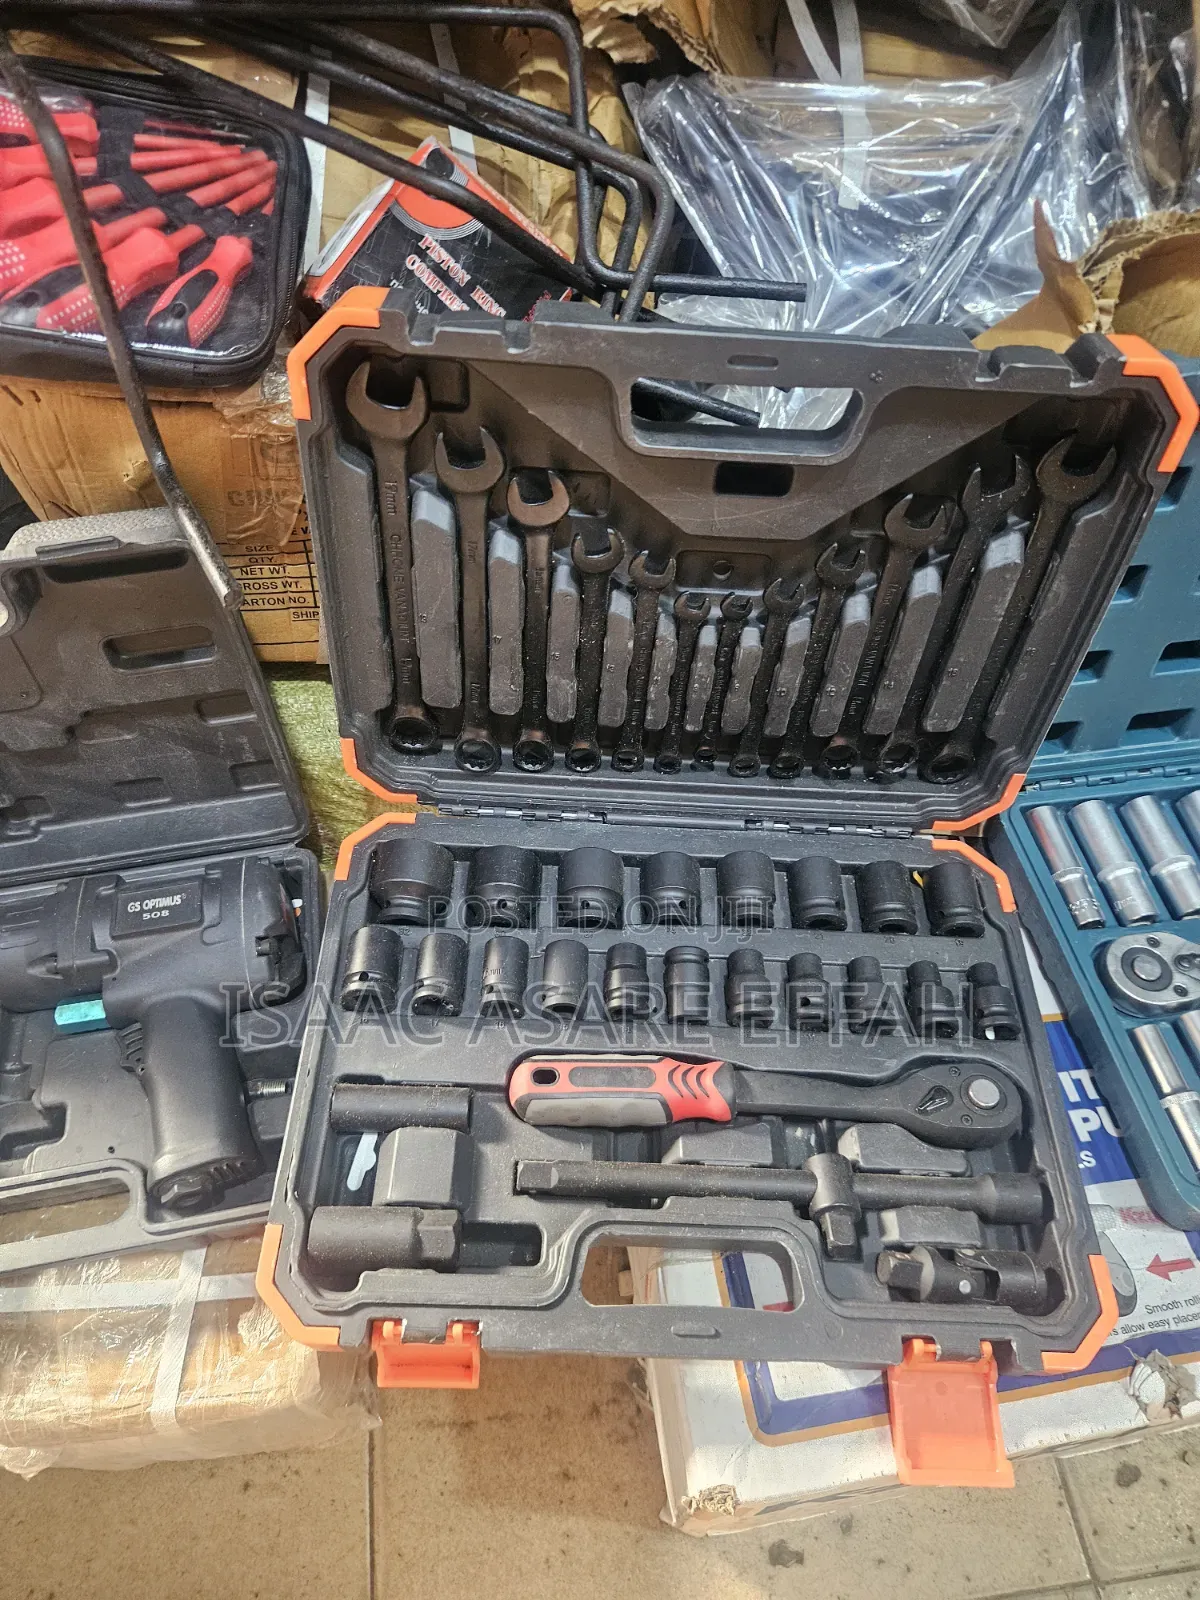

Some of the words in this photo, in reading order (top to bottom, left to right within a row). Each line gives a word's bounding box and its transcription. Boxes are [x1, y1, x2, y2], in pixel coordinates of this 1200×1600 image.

[418, 233, 472, 287] PISTON
[240, 567, 265, 576] NET
[269, 566, 290, 575] WT.
[240, 582, 278, 591] ROSS
[281, 581, 302, 589] WT.
[242, 598, 285, 607] ARTON
[127, 901, 141, 913] GS
[142, 910, 169, 920] 508
[1145, 1300, 1184, 1314] Smooth
[1120, 1324, 1145, 1335] allow
[1147, 1318, 1170, 1332] easy
